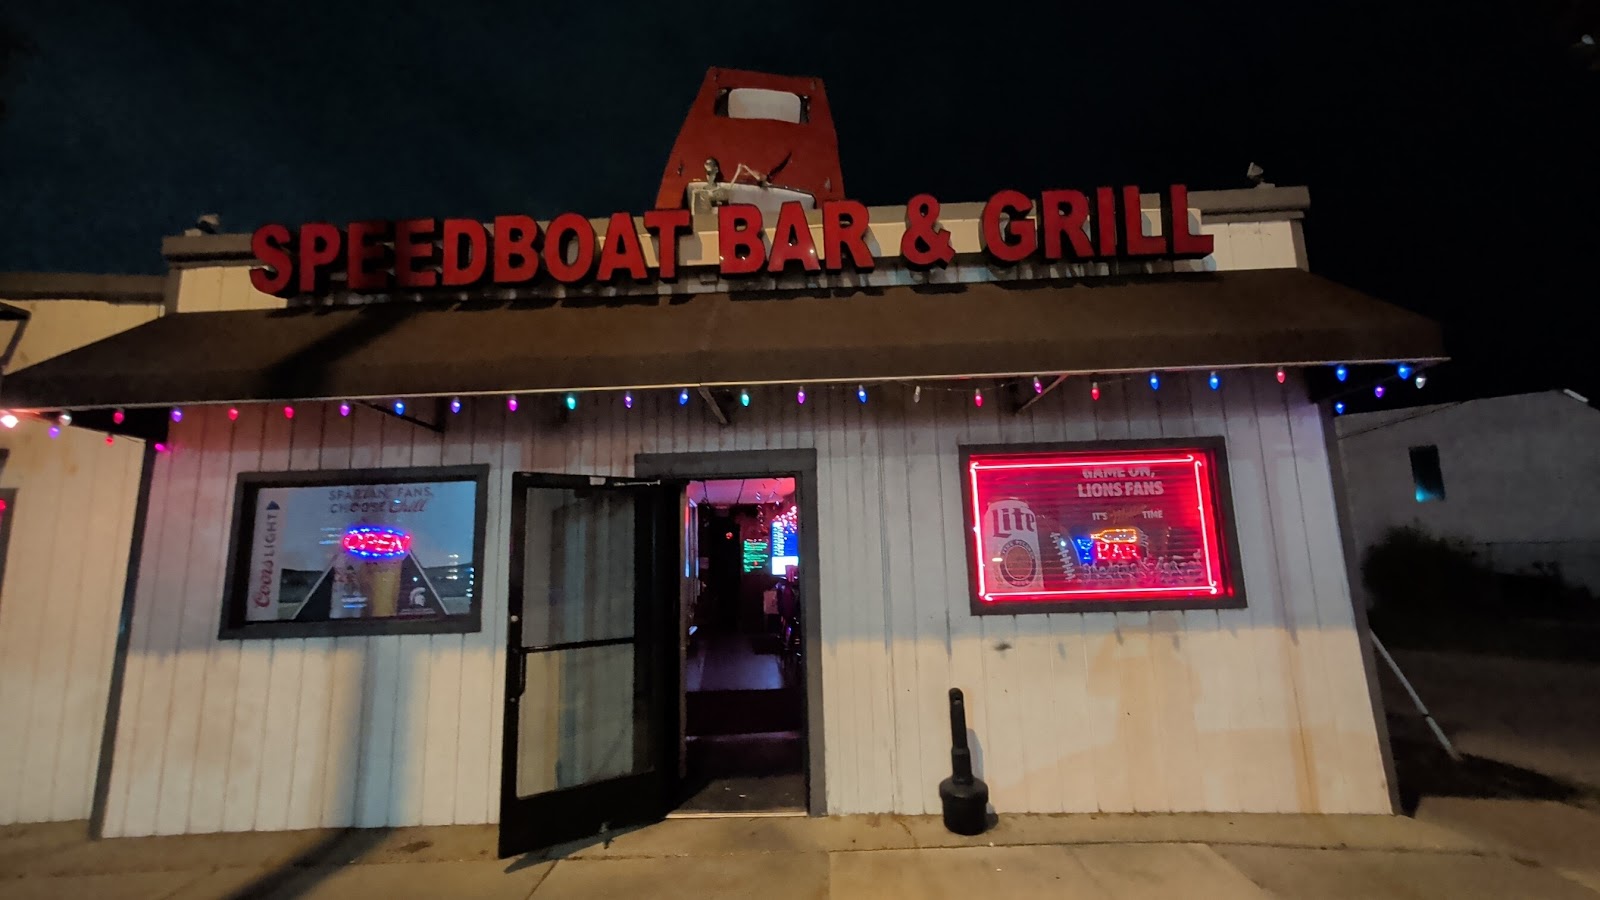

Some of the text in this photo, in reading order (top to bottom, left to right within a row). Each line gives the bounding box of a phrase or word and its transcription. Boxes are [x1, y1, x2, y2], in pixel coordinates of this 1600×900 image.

[250, 184, 1215, 297] SPEEDBOAT BAR & GRILL
[328, 487, 388, 501] SPARTAN
[1078, 480, 1164, 498] LIONS FANS
[330, 500, 386, 514] CHOOSE
[1092, 511, 1109, 521] IT'S
[1142, 509, 1163, 519] TIME
[992, 507, 1036, 540] Lite
[343, 528, 411, 553] OPEN
[1096, 541, 1141, 560] BAR
[255, 513, 278, 609] Coors LIGHT
